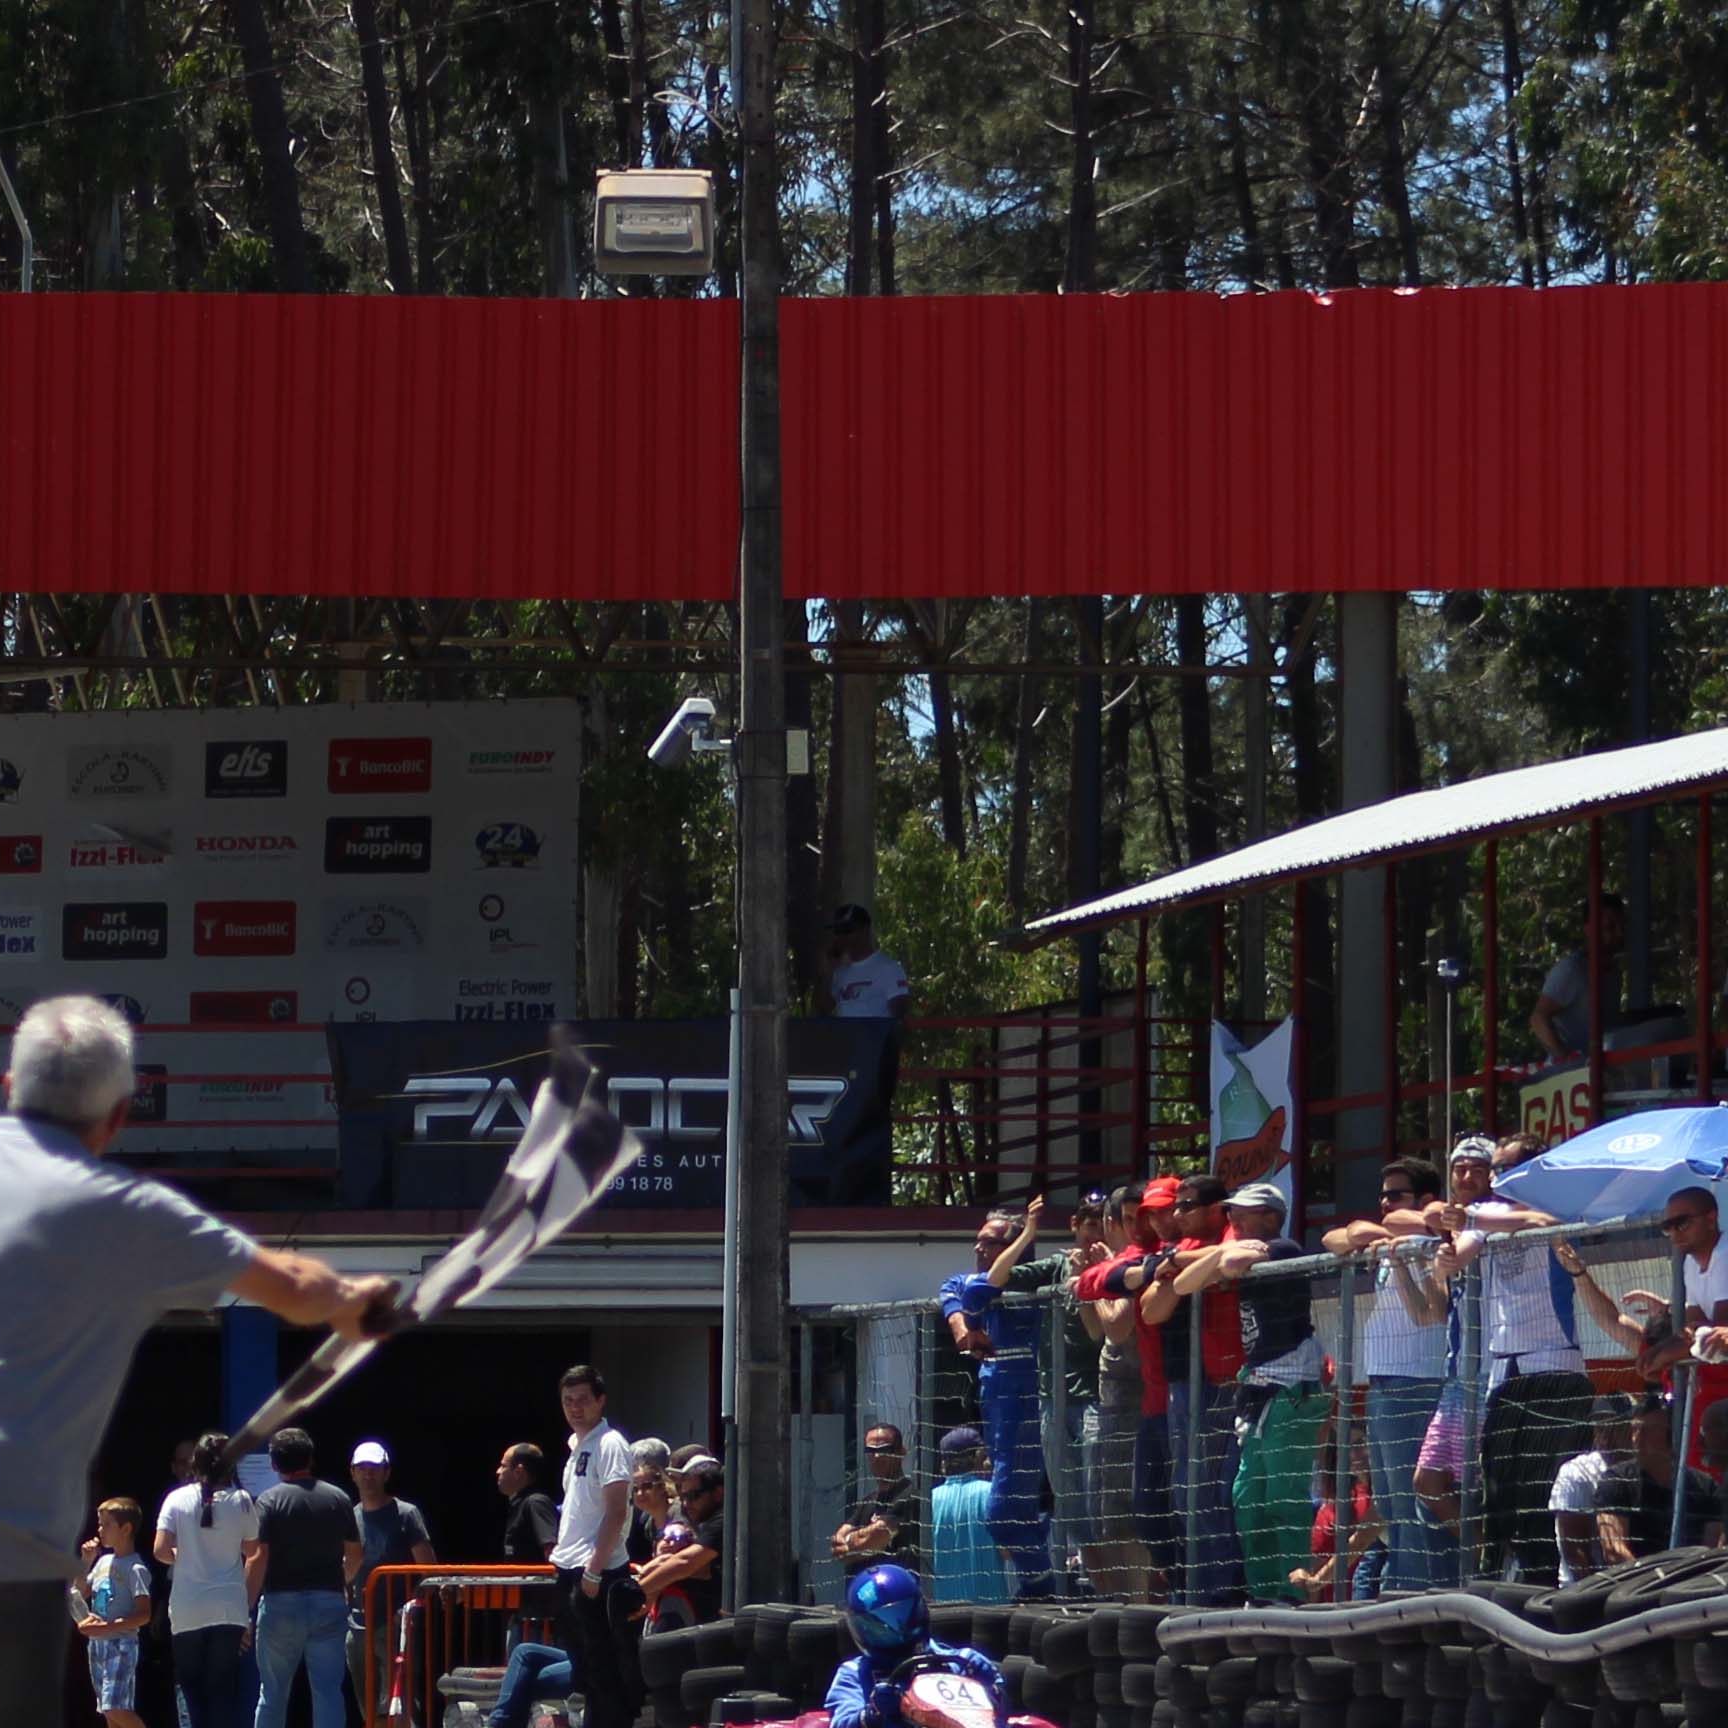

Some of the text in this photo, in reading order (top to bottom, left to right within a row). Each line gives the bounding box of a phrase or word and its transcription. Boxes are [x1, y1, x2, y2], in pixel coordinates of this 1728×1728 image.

[359, 758, 425, 775] BancoBIC
[195, 836, 298, 851] HONDA
[224, 921, 290, 938] BancoBIC
[489, 927, 513, 942] IPL
[459, 979, 553, 996] Electric Power
[454, 1002, 556, 1024] Izzi-Flex
[629, 1175, 650, 1191] 18
[653, 1175, 673, 1191] 78
[936, 1680, 975, 1703] 64
